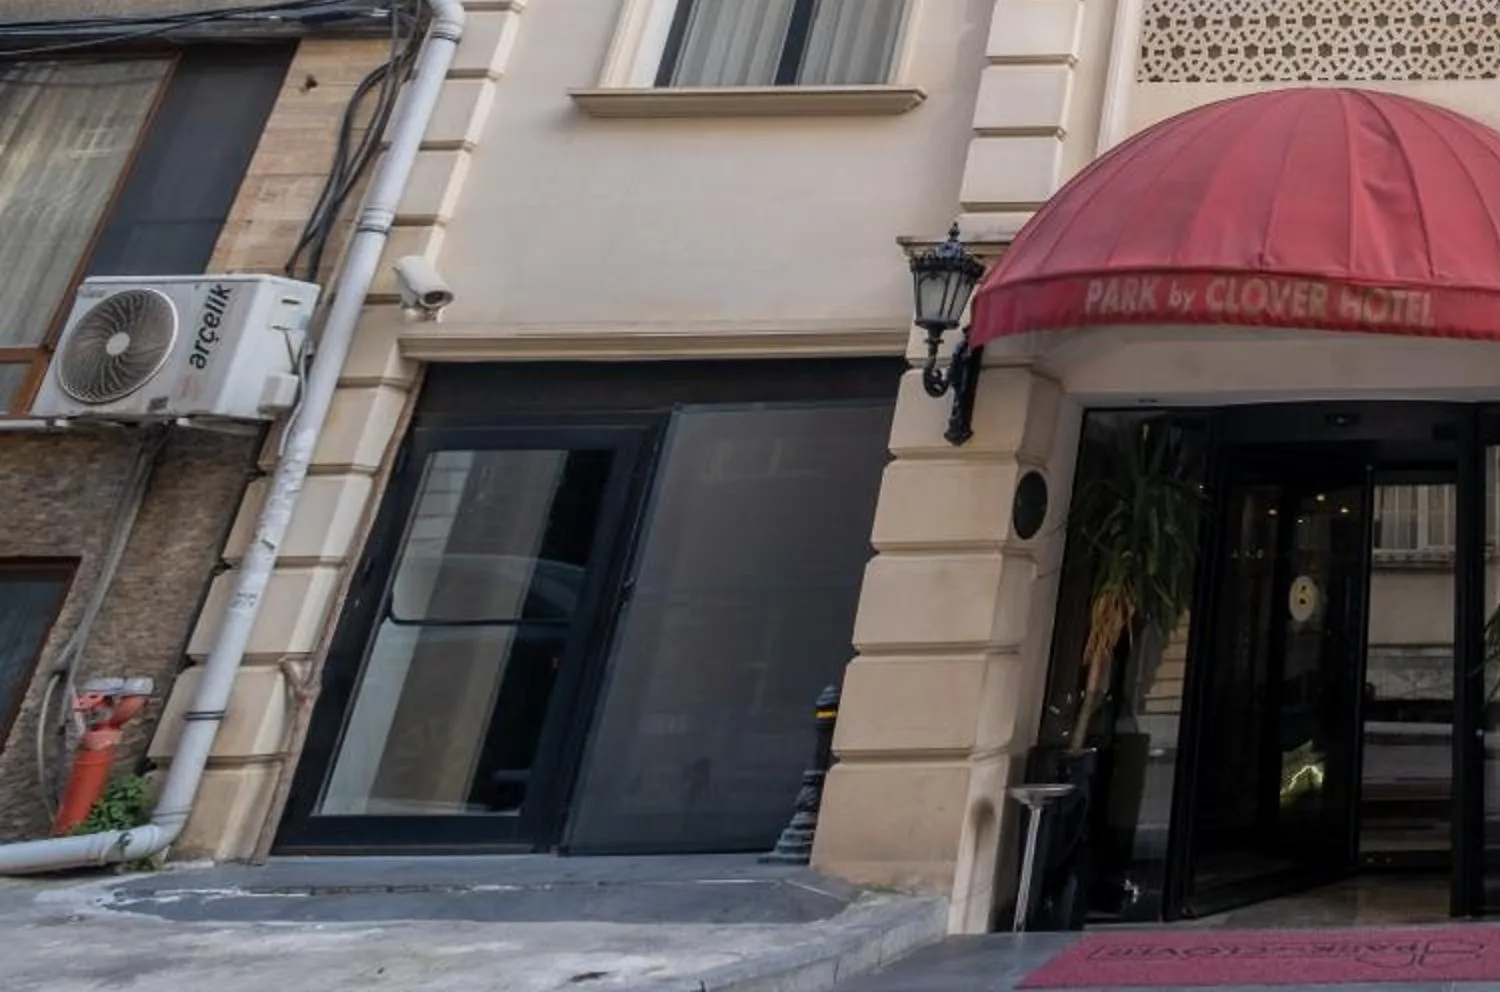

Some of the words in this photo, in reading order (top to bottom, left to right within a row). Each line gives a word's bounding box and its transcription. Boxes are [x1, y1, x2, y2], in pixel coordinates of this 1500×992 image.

[188, 283, 232, 370] arçelik
[1085, 276, 1162, 316] PARK
[1167, 279, 1197, 313] by
[1205, 276, 1329, 323] CLOVER
[1339, 284, 1436, 327] HOTEL
